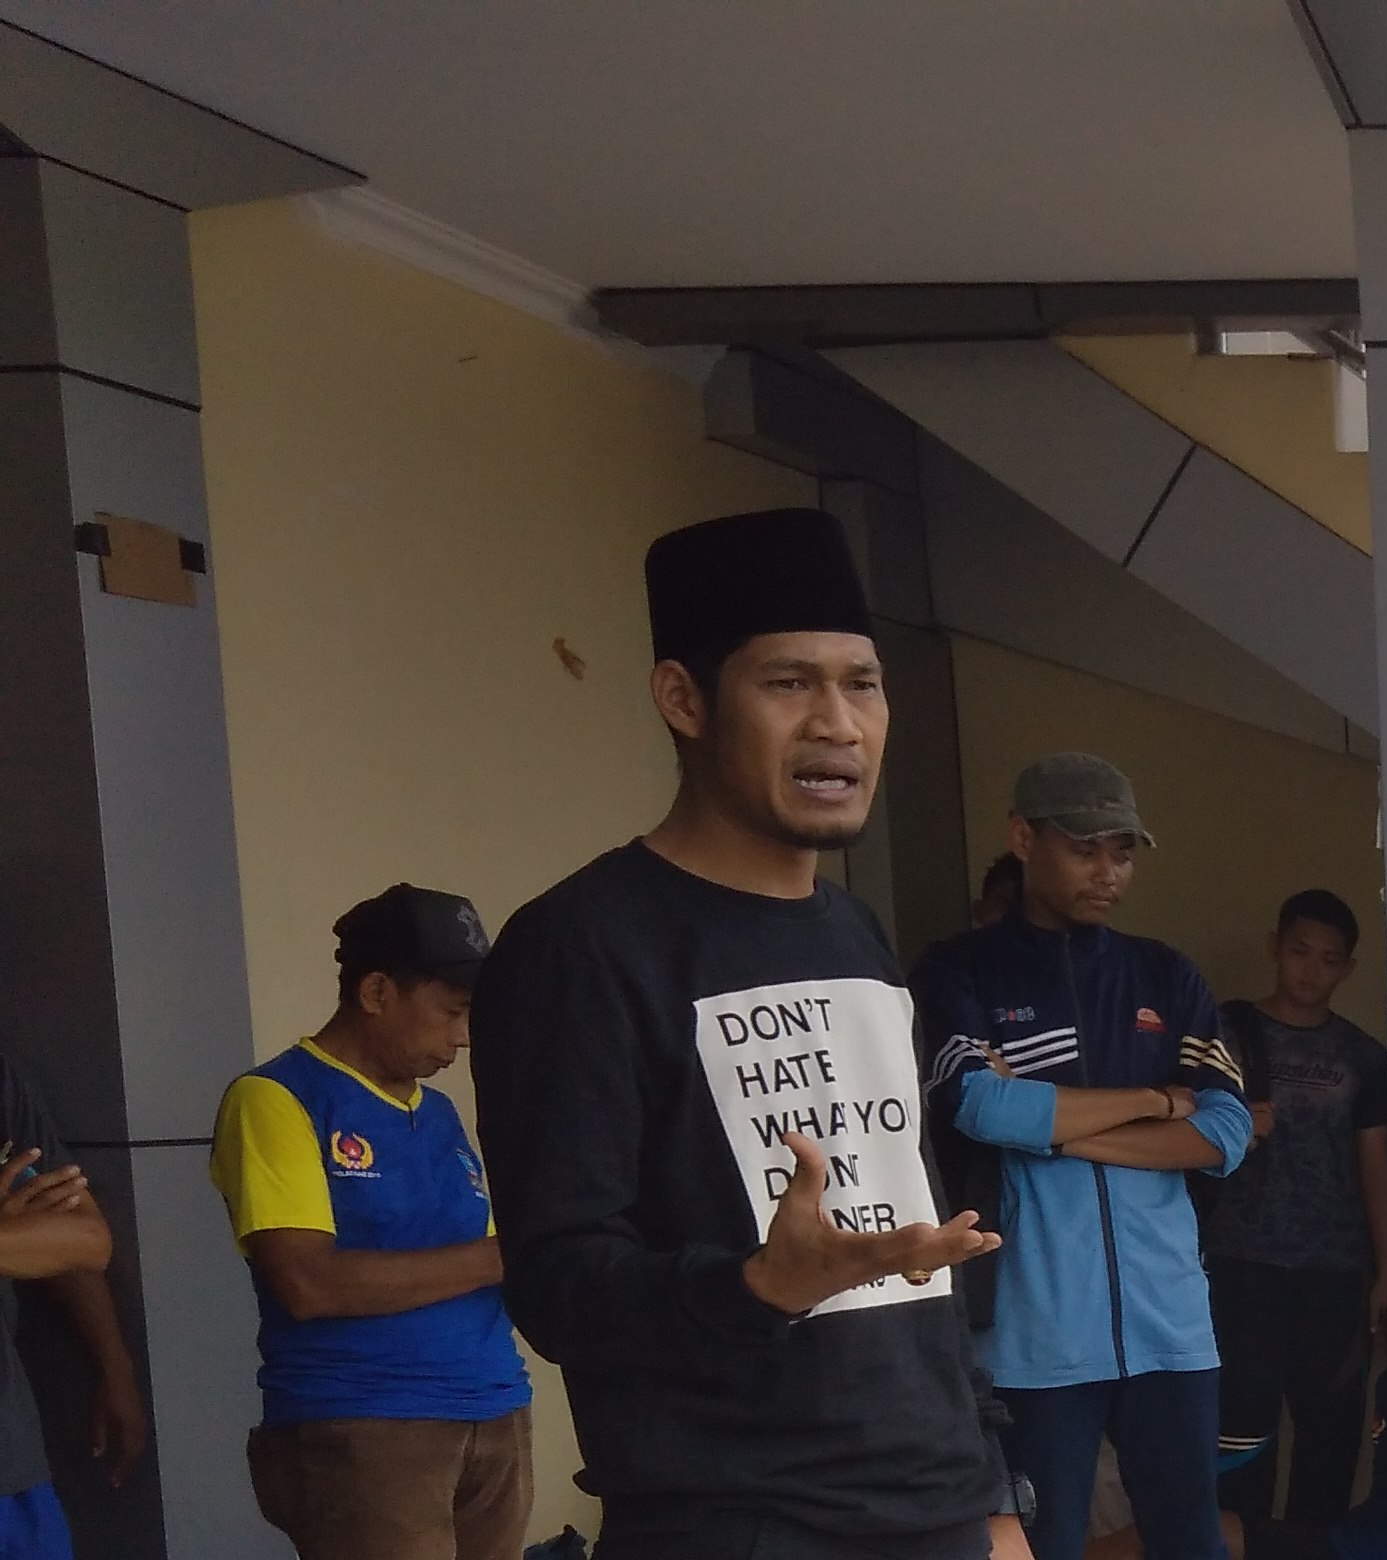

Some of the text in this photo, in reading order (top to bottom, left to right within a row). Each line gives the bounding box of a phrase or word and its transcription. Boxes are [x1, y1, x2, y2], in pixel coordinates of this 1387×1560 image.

[716, 998, 831, 1047] DON'T
[736, 1049, 836, 1099] HATE
[750, 1098, 912, 1149] WHA YO
